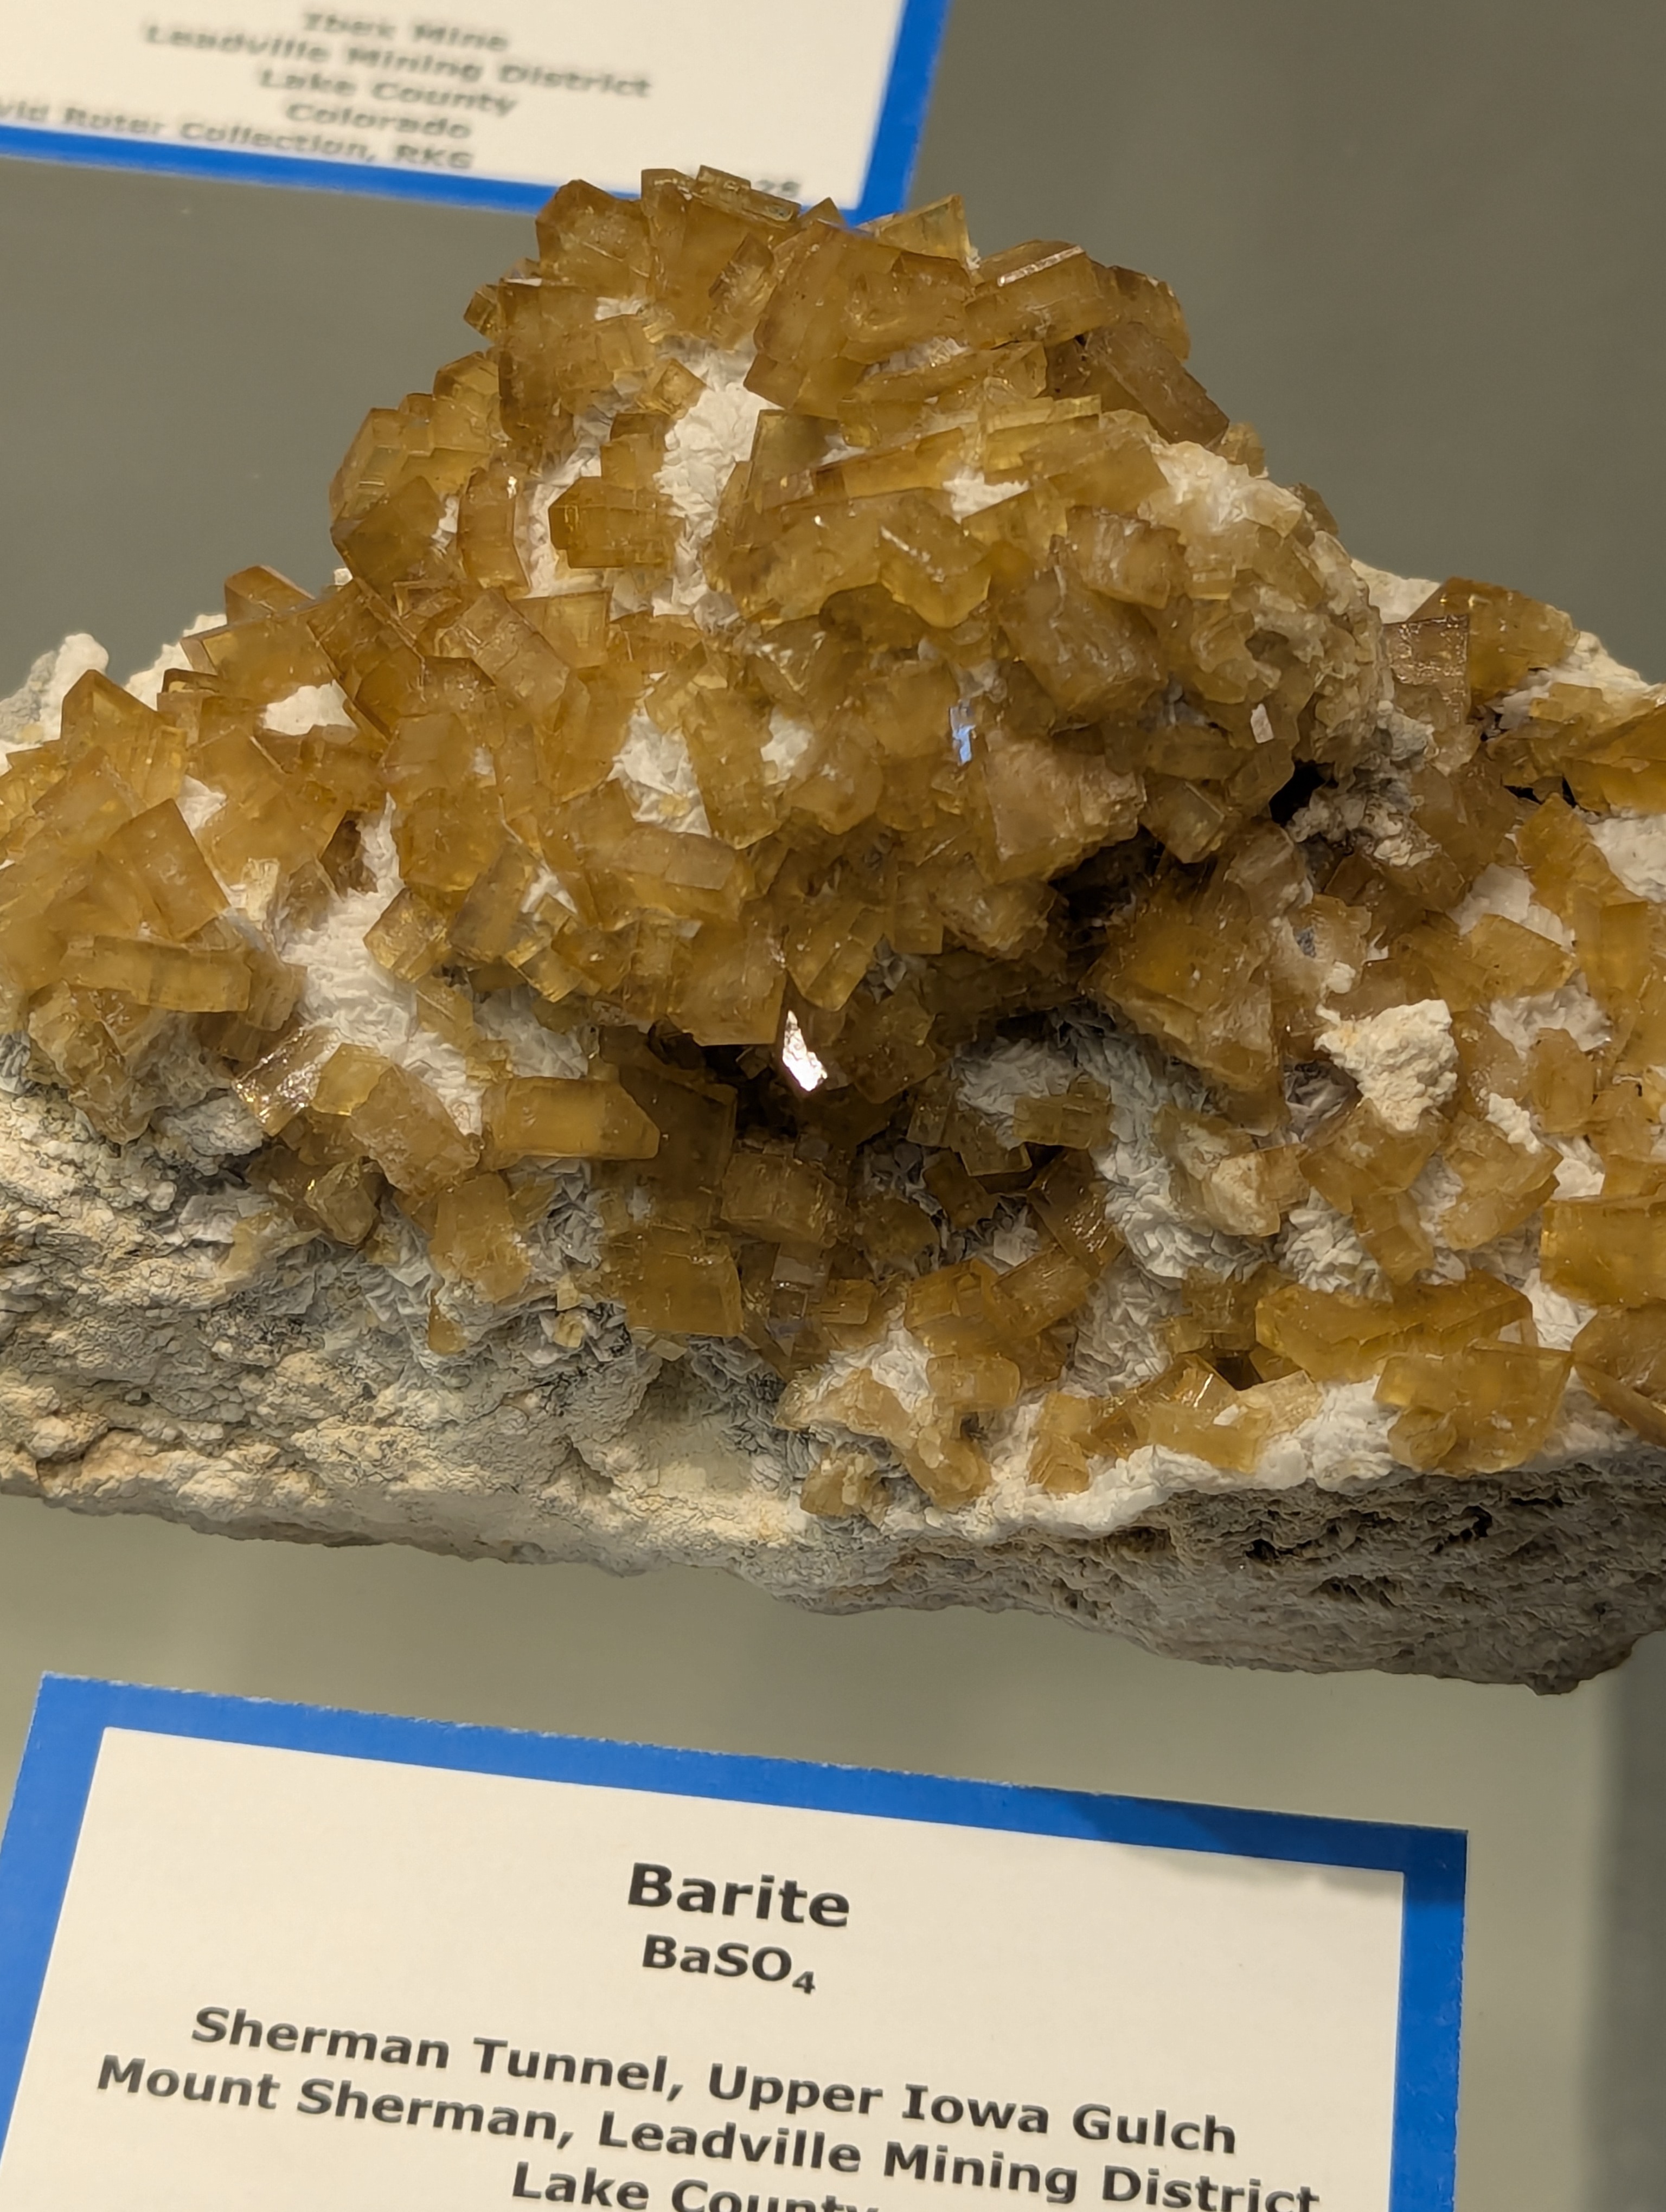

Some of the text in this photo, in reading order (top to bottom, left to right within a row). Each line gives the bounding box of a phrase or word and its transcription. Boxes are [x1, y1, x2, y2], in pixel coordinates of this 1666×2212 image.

[301, 11, 510, 53] Ibex Mine
[144, 24, 652, 99] Leadville Mining District
[259, 68, 518, 117] Lake County
[180, 120, 376, 163] Collection,
[395, 143, 474, 170] RKG
[286, 103, 473, 140] Colorado
[628, 1863, 849, 1927] Barite
[191, 2006, 1236, 2154] Sherman Tunnel, Upper Iowa Gulch
[97, 2054, 1319, 2212] Mount Sherman, Leadville Mining District
[512, 2162, 879, 2212] Lake Count
